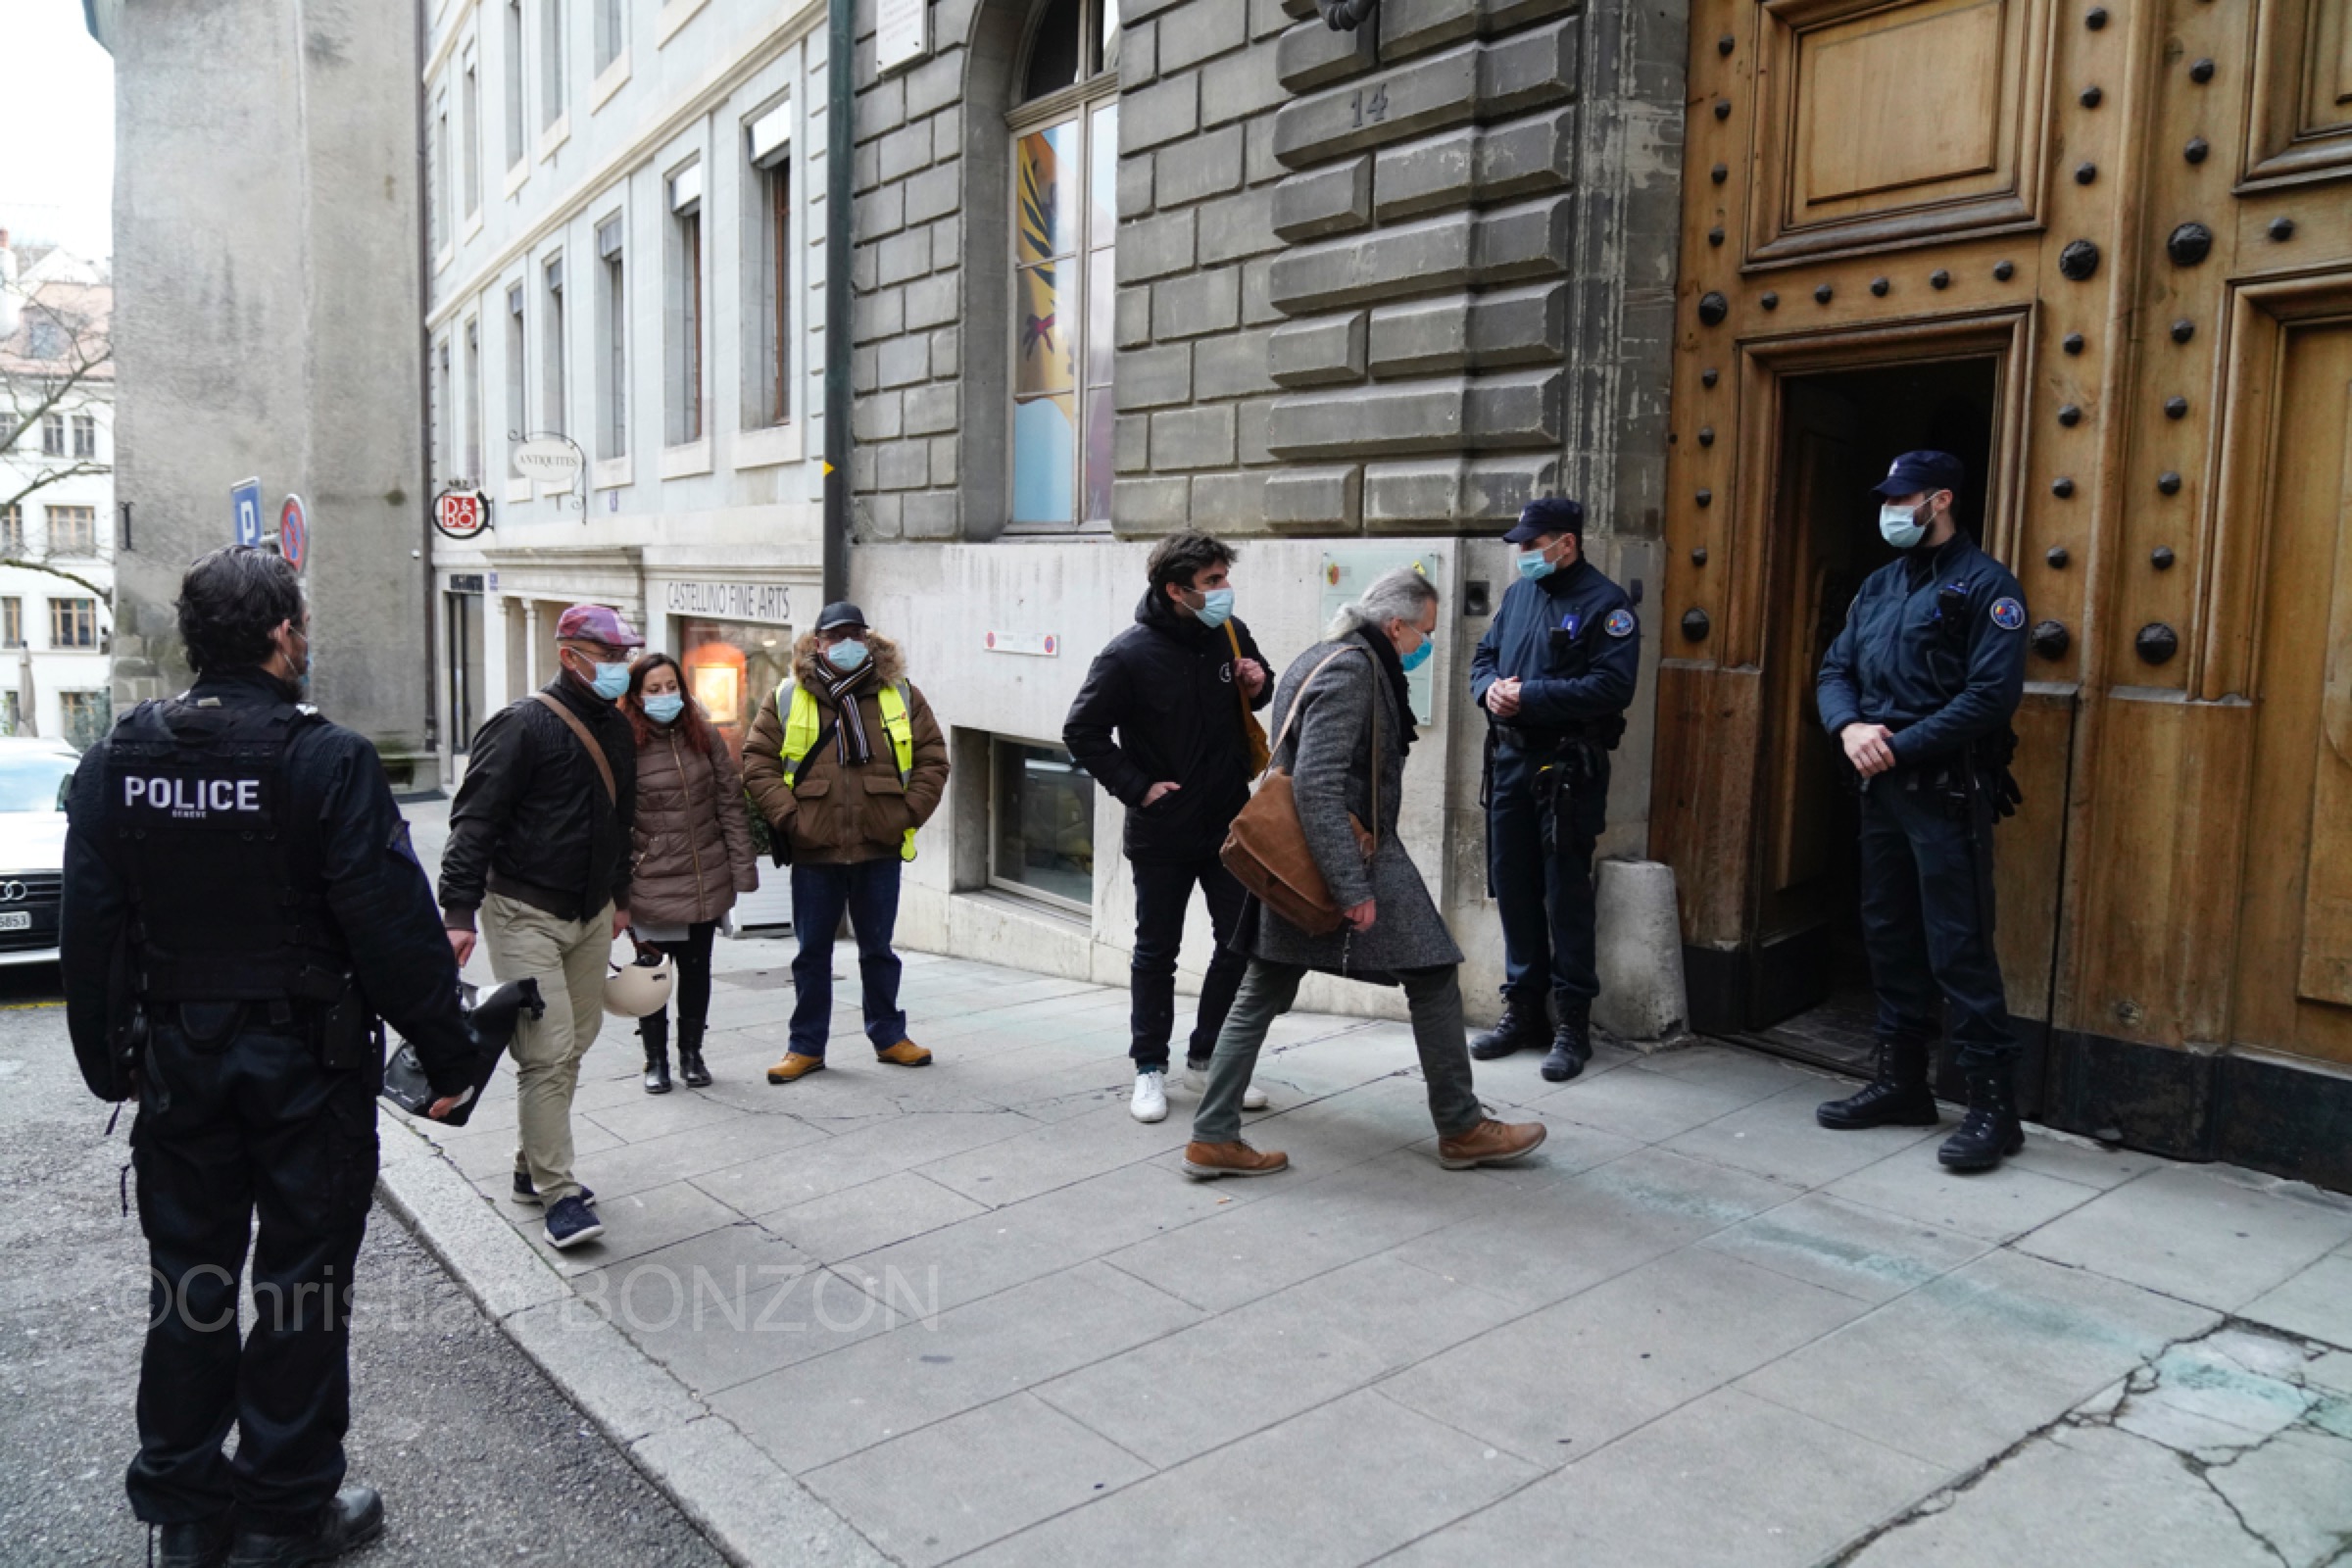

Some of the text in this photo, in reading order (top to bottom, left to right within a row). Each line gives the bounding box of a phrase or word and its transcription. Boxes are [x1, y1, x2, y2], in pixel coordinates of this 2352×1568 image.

[1349, 82, 1389, 128] 14
[240, 500, 256, 546] P
[667, 582, 791, 619] CASTELLINO FINE ARTS
[124, 775, 260, 811] POLICE
